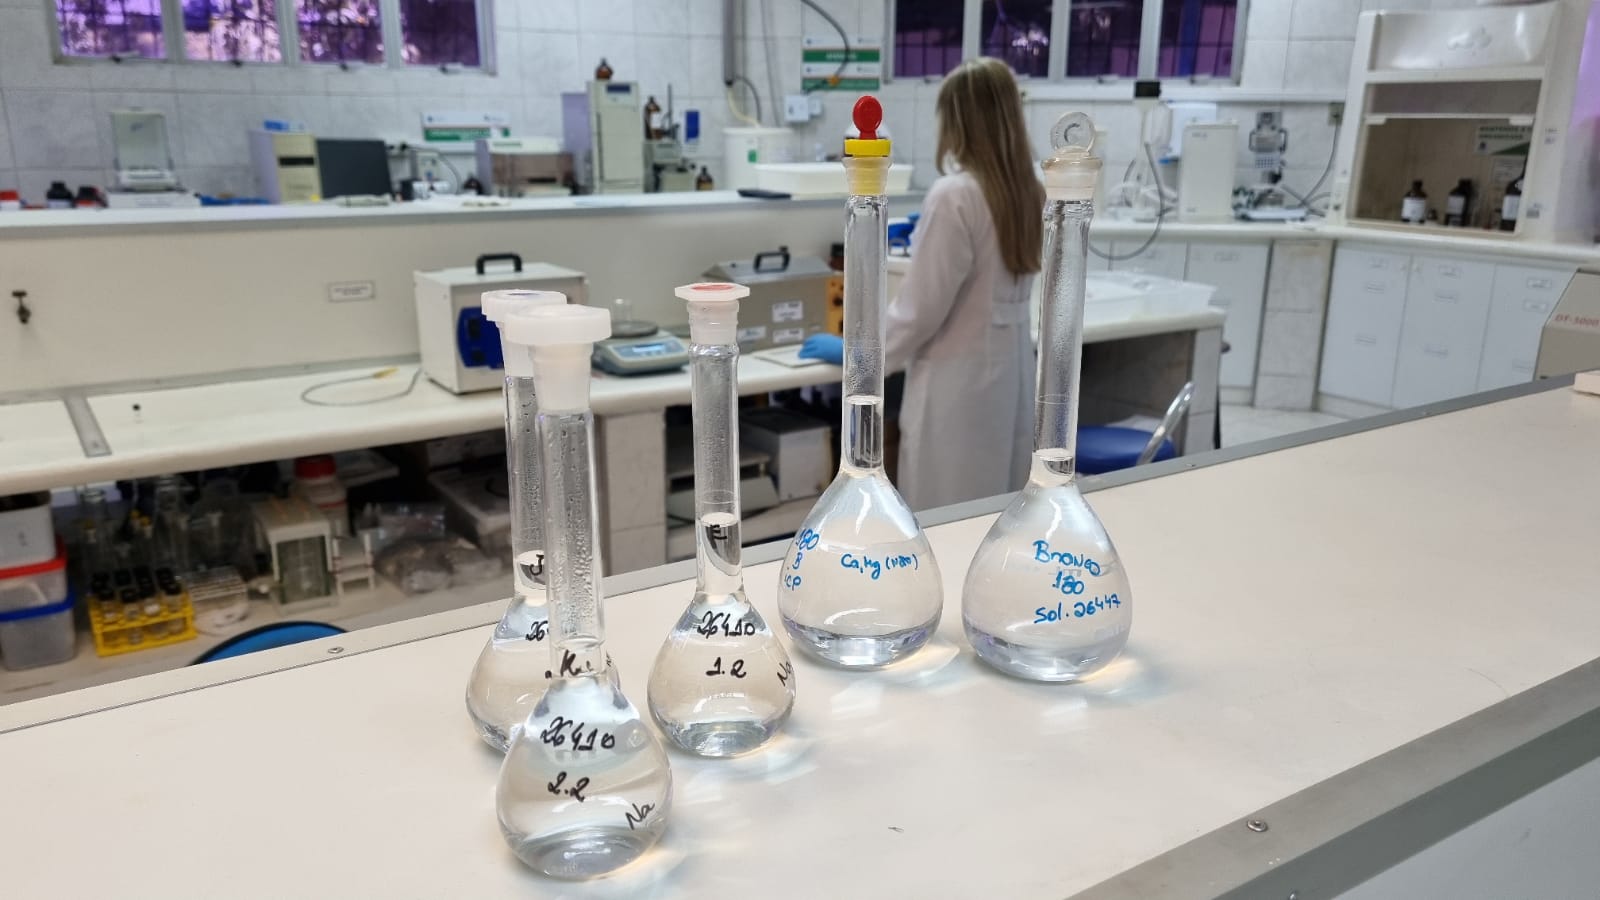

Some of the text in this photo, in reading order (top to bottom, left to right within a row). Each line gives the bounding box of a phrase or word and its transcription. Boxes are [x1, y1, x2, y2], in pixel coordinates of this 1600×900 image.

[525, 620, 550, 641] 26
[697, 611, 756, 639] 26410
[706, 656, 747, 679] 1.2
[540, 716, 616, 751] 26410
[547, 771, 590, 803] 2.2
[625, 802, 656, 831] Na
